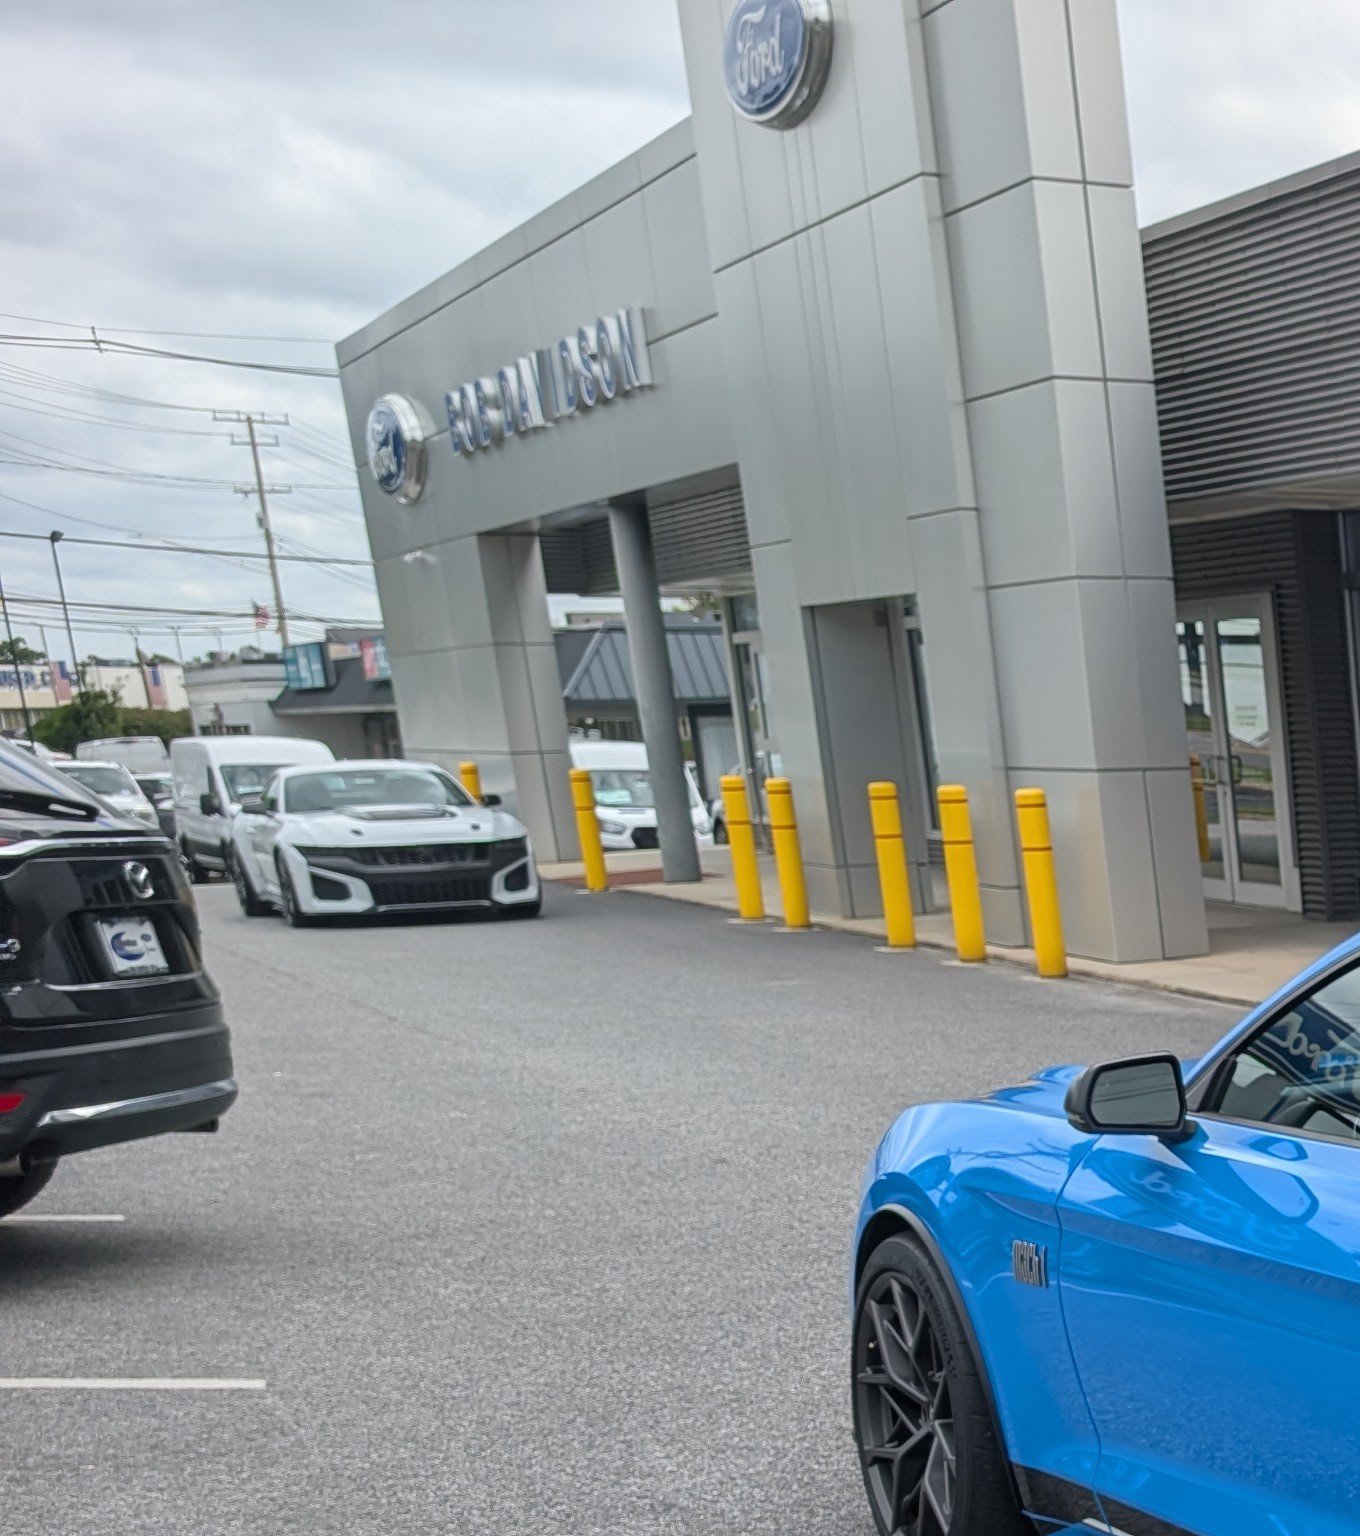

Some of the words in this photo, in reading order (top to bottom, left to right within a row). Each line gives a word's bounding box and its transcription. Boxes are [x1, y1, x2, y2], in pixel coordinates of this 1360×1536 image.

[735, 4, 785, 97] Ford
[444, 375, 504, 457] BOB
[498, 306, 653, 438] DAVIDSON
